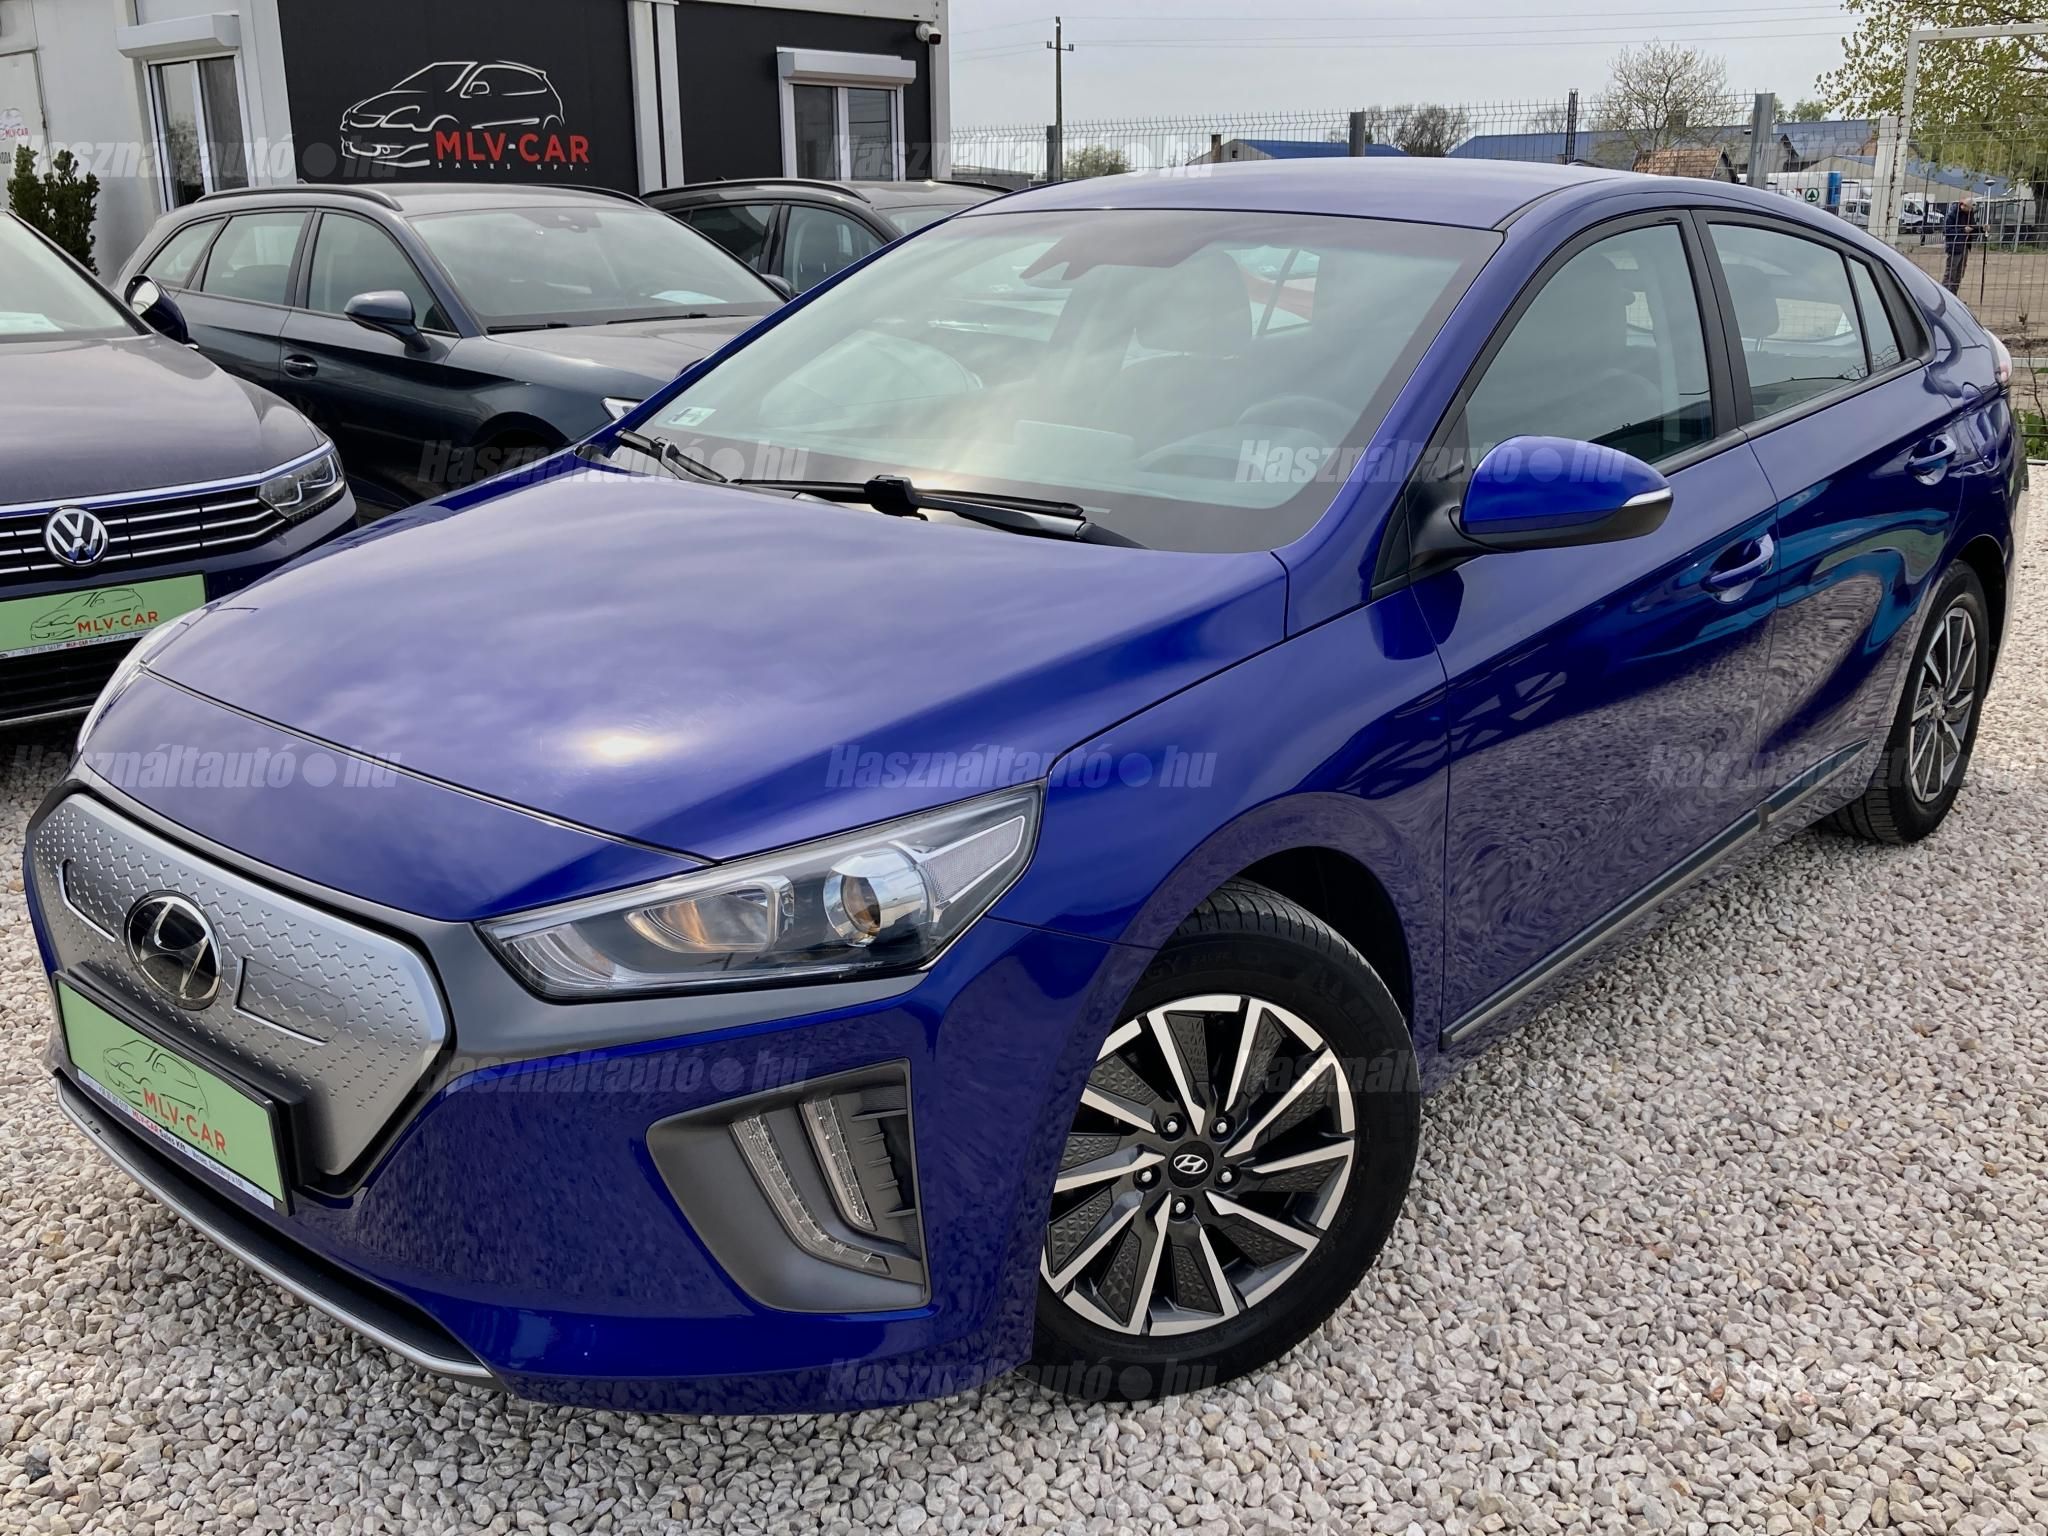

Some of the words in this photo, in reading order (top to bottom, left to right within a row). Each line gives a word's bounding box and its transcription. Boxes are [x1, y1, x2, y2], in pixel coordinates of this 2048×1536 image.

[435, 130, 590, 163] MLV-CAR
[437, 161, 511, 170] SALES
[77, 611, 159, 634] MLV-CAR
[143, 1087, 228, 1156] MLV-CAR
